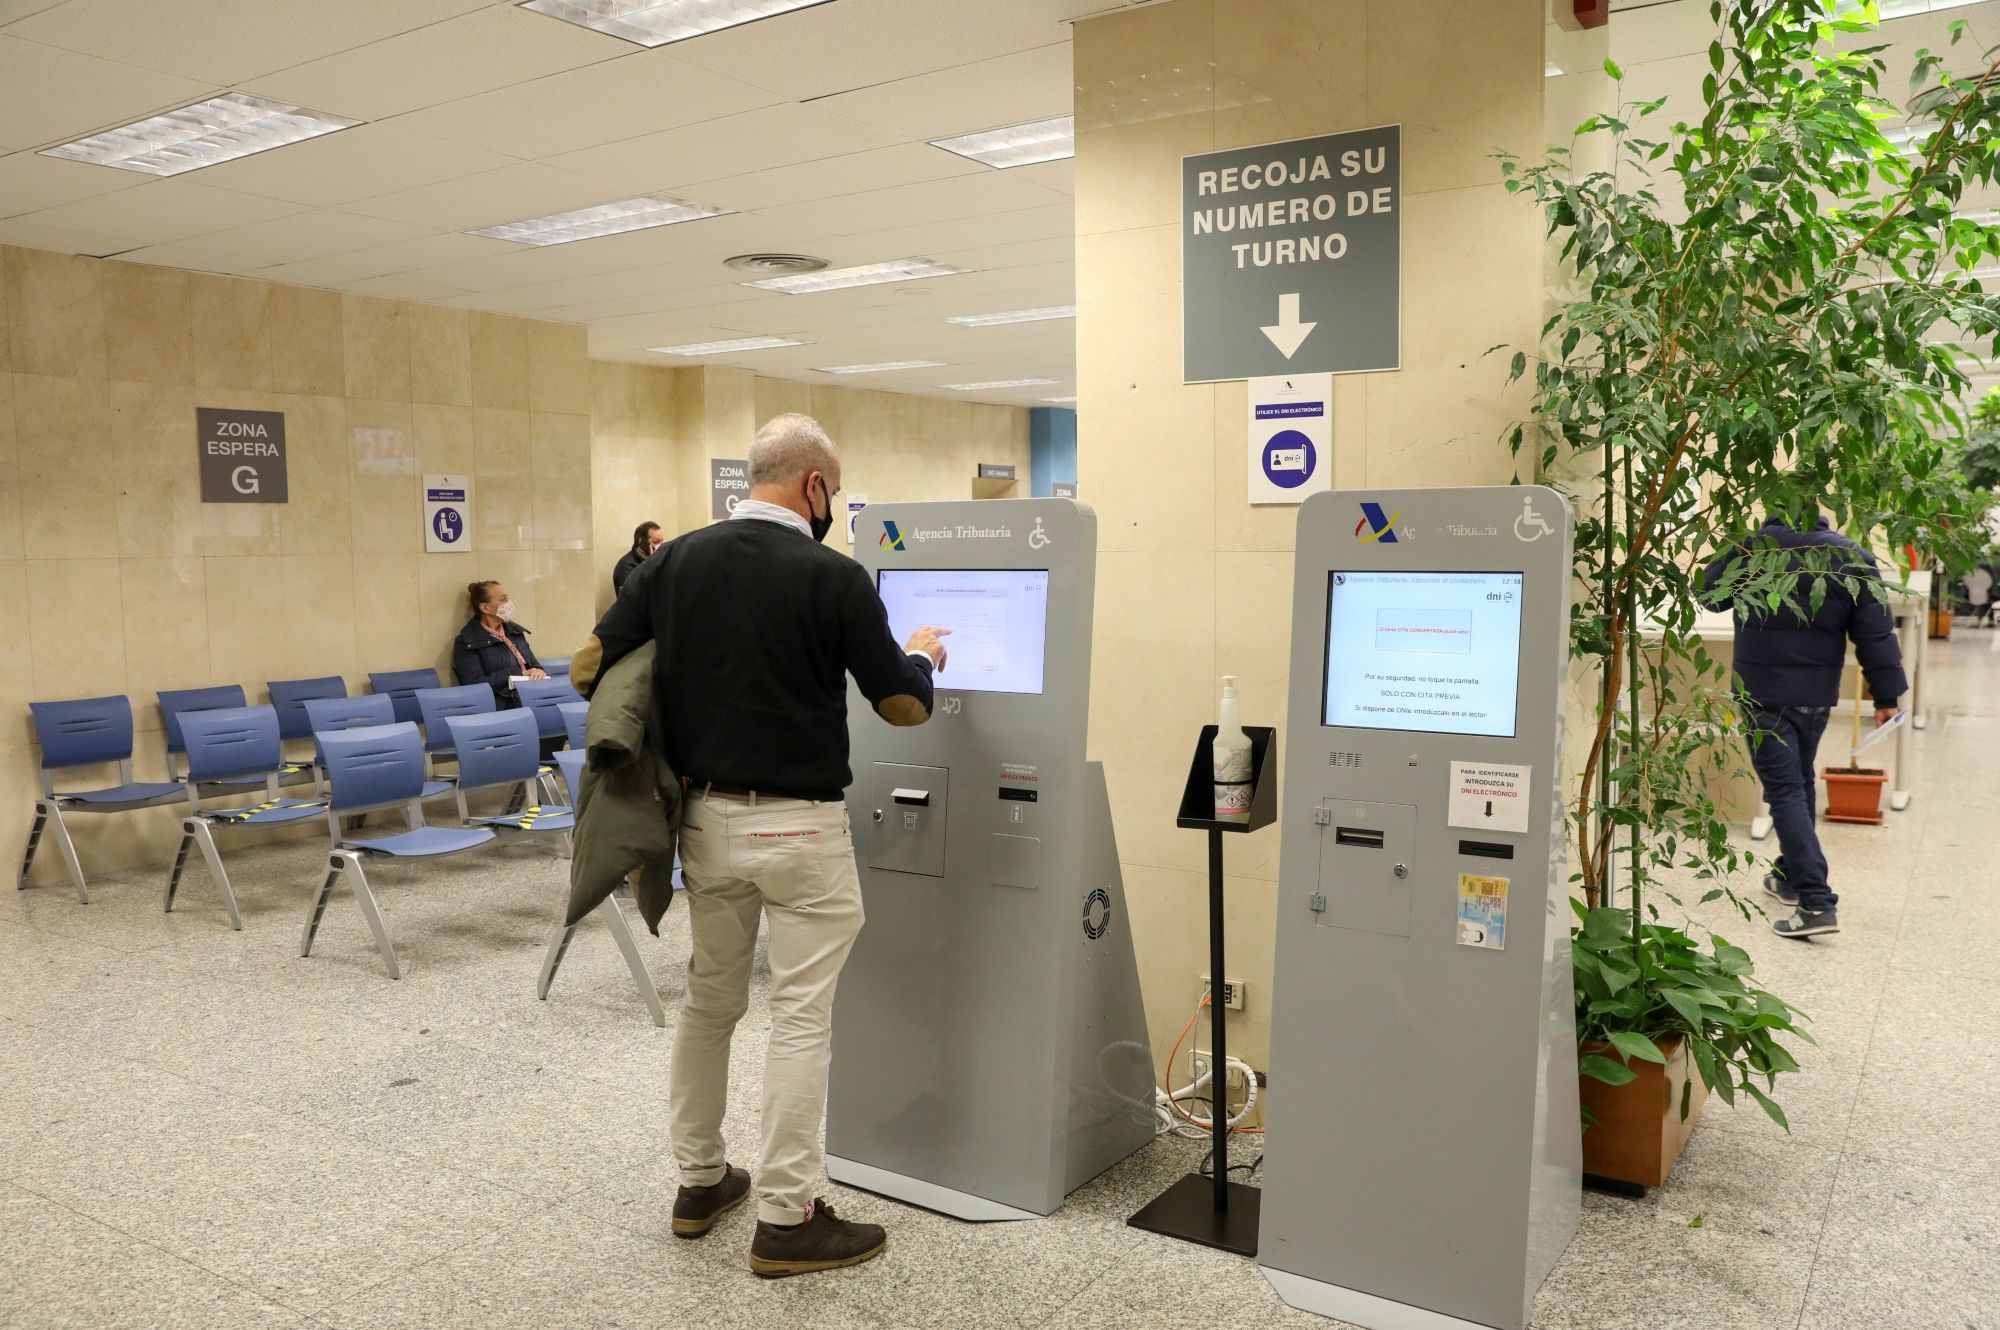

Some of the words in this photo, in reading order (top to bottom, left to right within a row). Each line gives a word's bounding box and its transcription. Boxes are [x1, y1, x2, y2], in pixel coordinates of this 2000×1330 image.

[1198, 154, 1331, 196] RECOJA
[1340, 146, 1386, 178] SU
[1193, 194, 1336, 235] NUMERO
[1347, 186, 1393, 217] DE
[1231, 233, 1348, 269] TURNO
[216, 422, 268, 438] ZONA
[207, 441, 279, 457] ESPERA
[1284, 454, 1294, 462] dni
[719, 467, 745, 477] ZONA
[231, 465, 260, 494] G
[715, 479, 750, 490] ESPERA
[1056, 488, 1072, 497] ZONA
[912, 527, 952, 542] Agencia
[955, 526, 1011, 539] Tributaria
[1486, 592, 1501, 601] dni
[1446, 676, 1453, 684] la
[1454, 677, 1479, 685] pantalla
[1362, 705, 1385, 713] dispone
[1479, 770, 1520, 778] IDENTIFICARSE
[1465, 778, 1505, 787] INTRODUZCA
